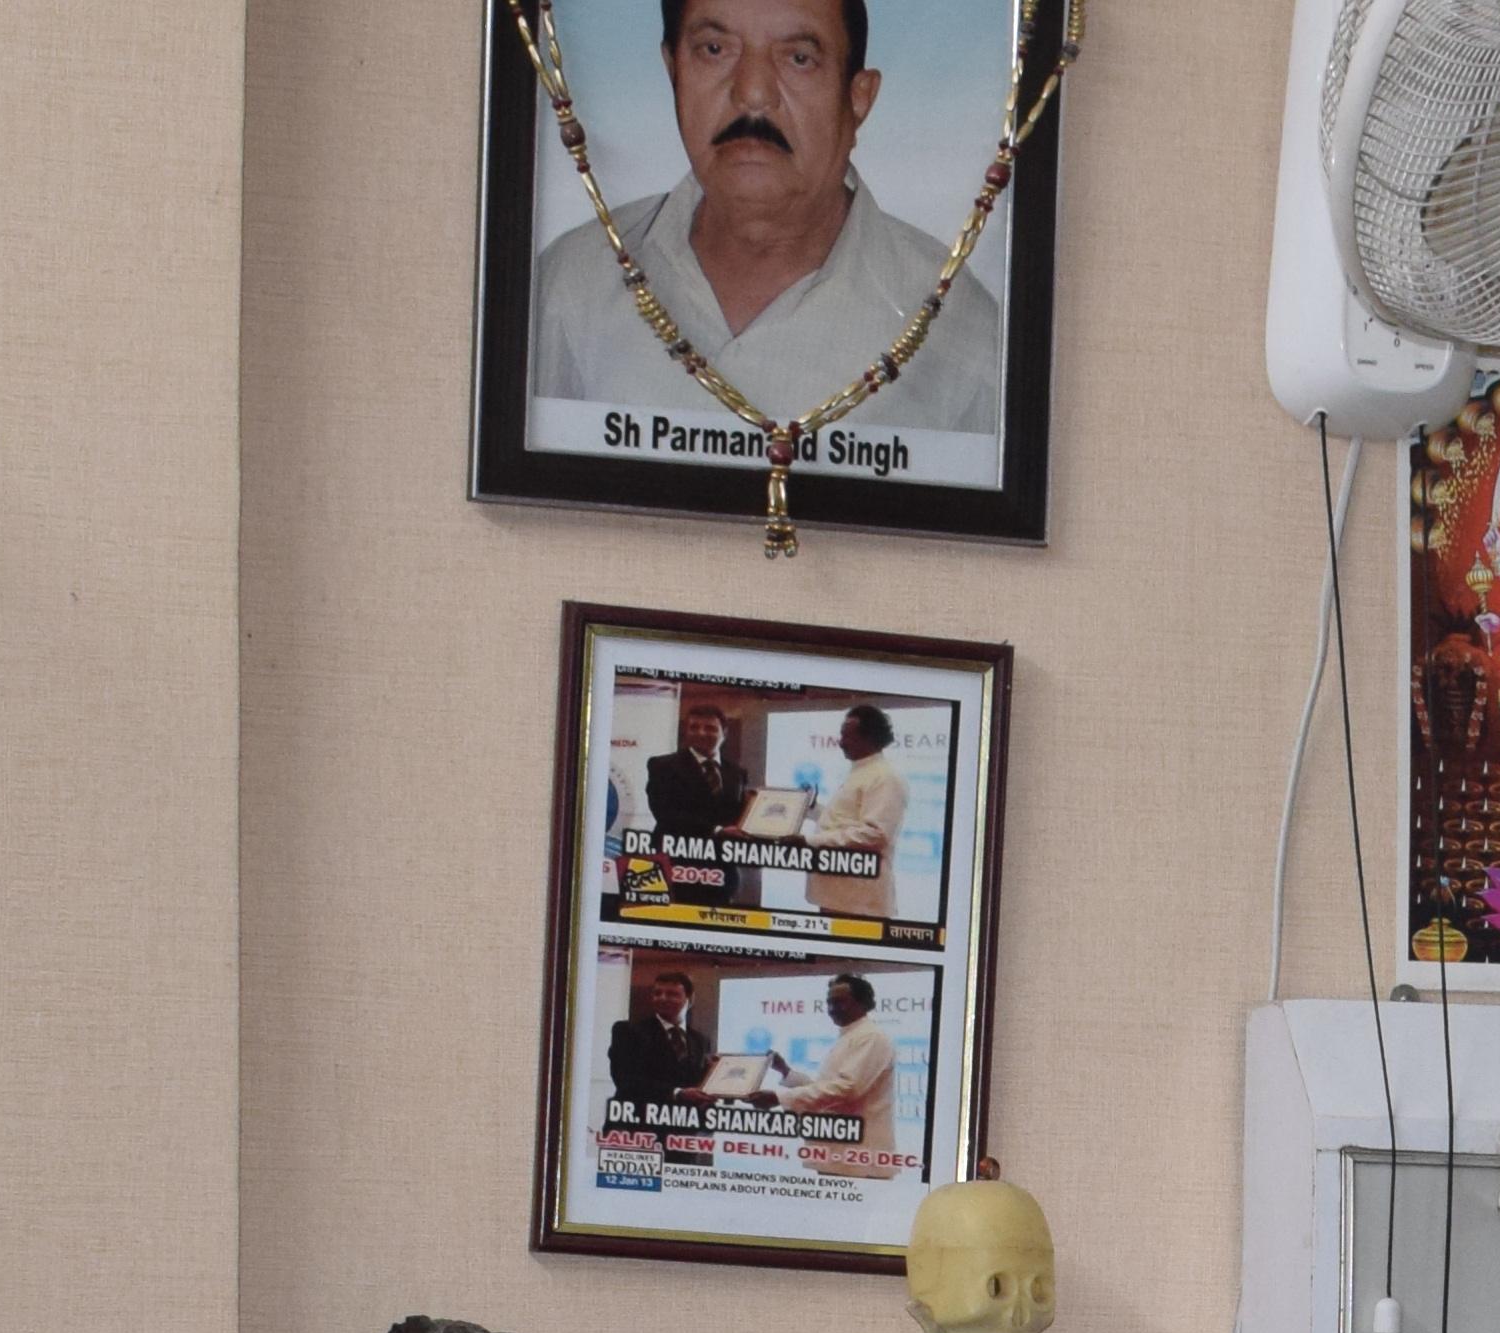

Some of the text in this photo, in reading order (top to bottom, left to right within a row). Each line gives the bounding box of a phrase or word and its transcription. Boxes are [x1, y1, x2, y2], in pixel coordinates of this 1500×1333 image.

[603, 411, 909, 476] Sh Parmand Singh
[625, 830, 878, 877] DR. RAMA SHANKAR SINGH
[672, 866, 724, 885] 2012
[771, 915, 802, 929] Temp.
[804, 919, 817, 930] 21
[889, 925, 935, 941] तापमान
[761, 999, 805, 1015] TIME
[608, 1099, 861, 1142] DR. RAMA SHANKAR SINGH
[606, 1151, 656, 1162] HEADLINES
[666, 1134, 716, 1153] NEW
[722, 1140, 790, 1160] DELHI,
[796, 1146, 828, 1161] ON
[846, 1150, 871, 1165] 26
[603, 1158, 658, 1177] TODAY
[663, 1165, 718, 1179] PAKISTAN
[719, 1170, 777, 1184] SUMMONS
[779, 1174, 816, 1187] INDIAN
[605, 1175, 654, 1188] 12 Jan 13
[663, 1178, 864, 1203] COMPLAINS ABOUT VIOLENCE AT LOC
